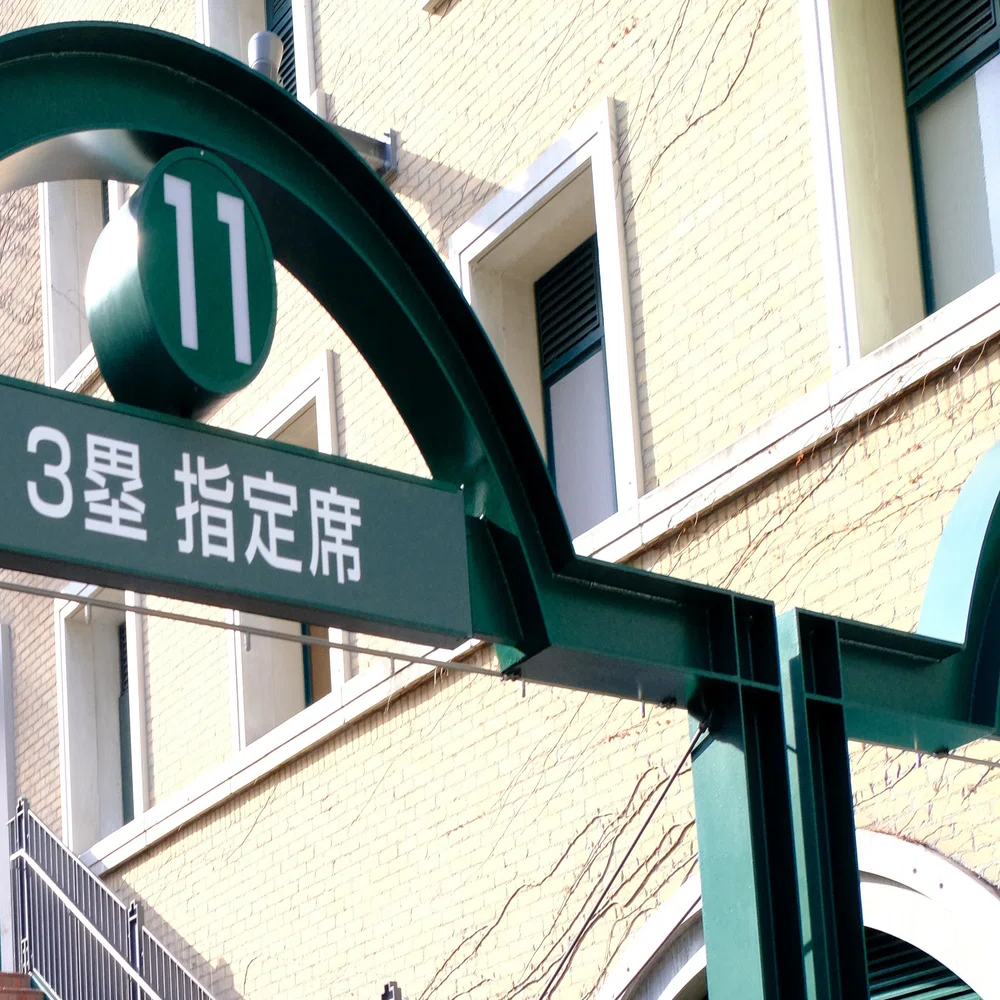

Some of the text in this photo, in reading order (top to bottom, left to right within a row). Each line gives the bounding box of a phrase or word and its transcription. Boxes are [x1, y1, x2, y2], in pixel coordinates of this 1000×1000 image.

[163, 173, 252, 366] 11
[26, 426, 362, 585] 3塁 指定席
